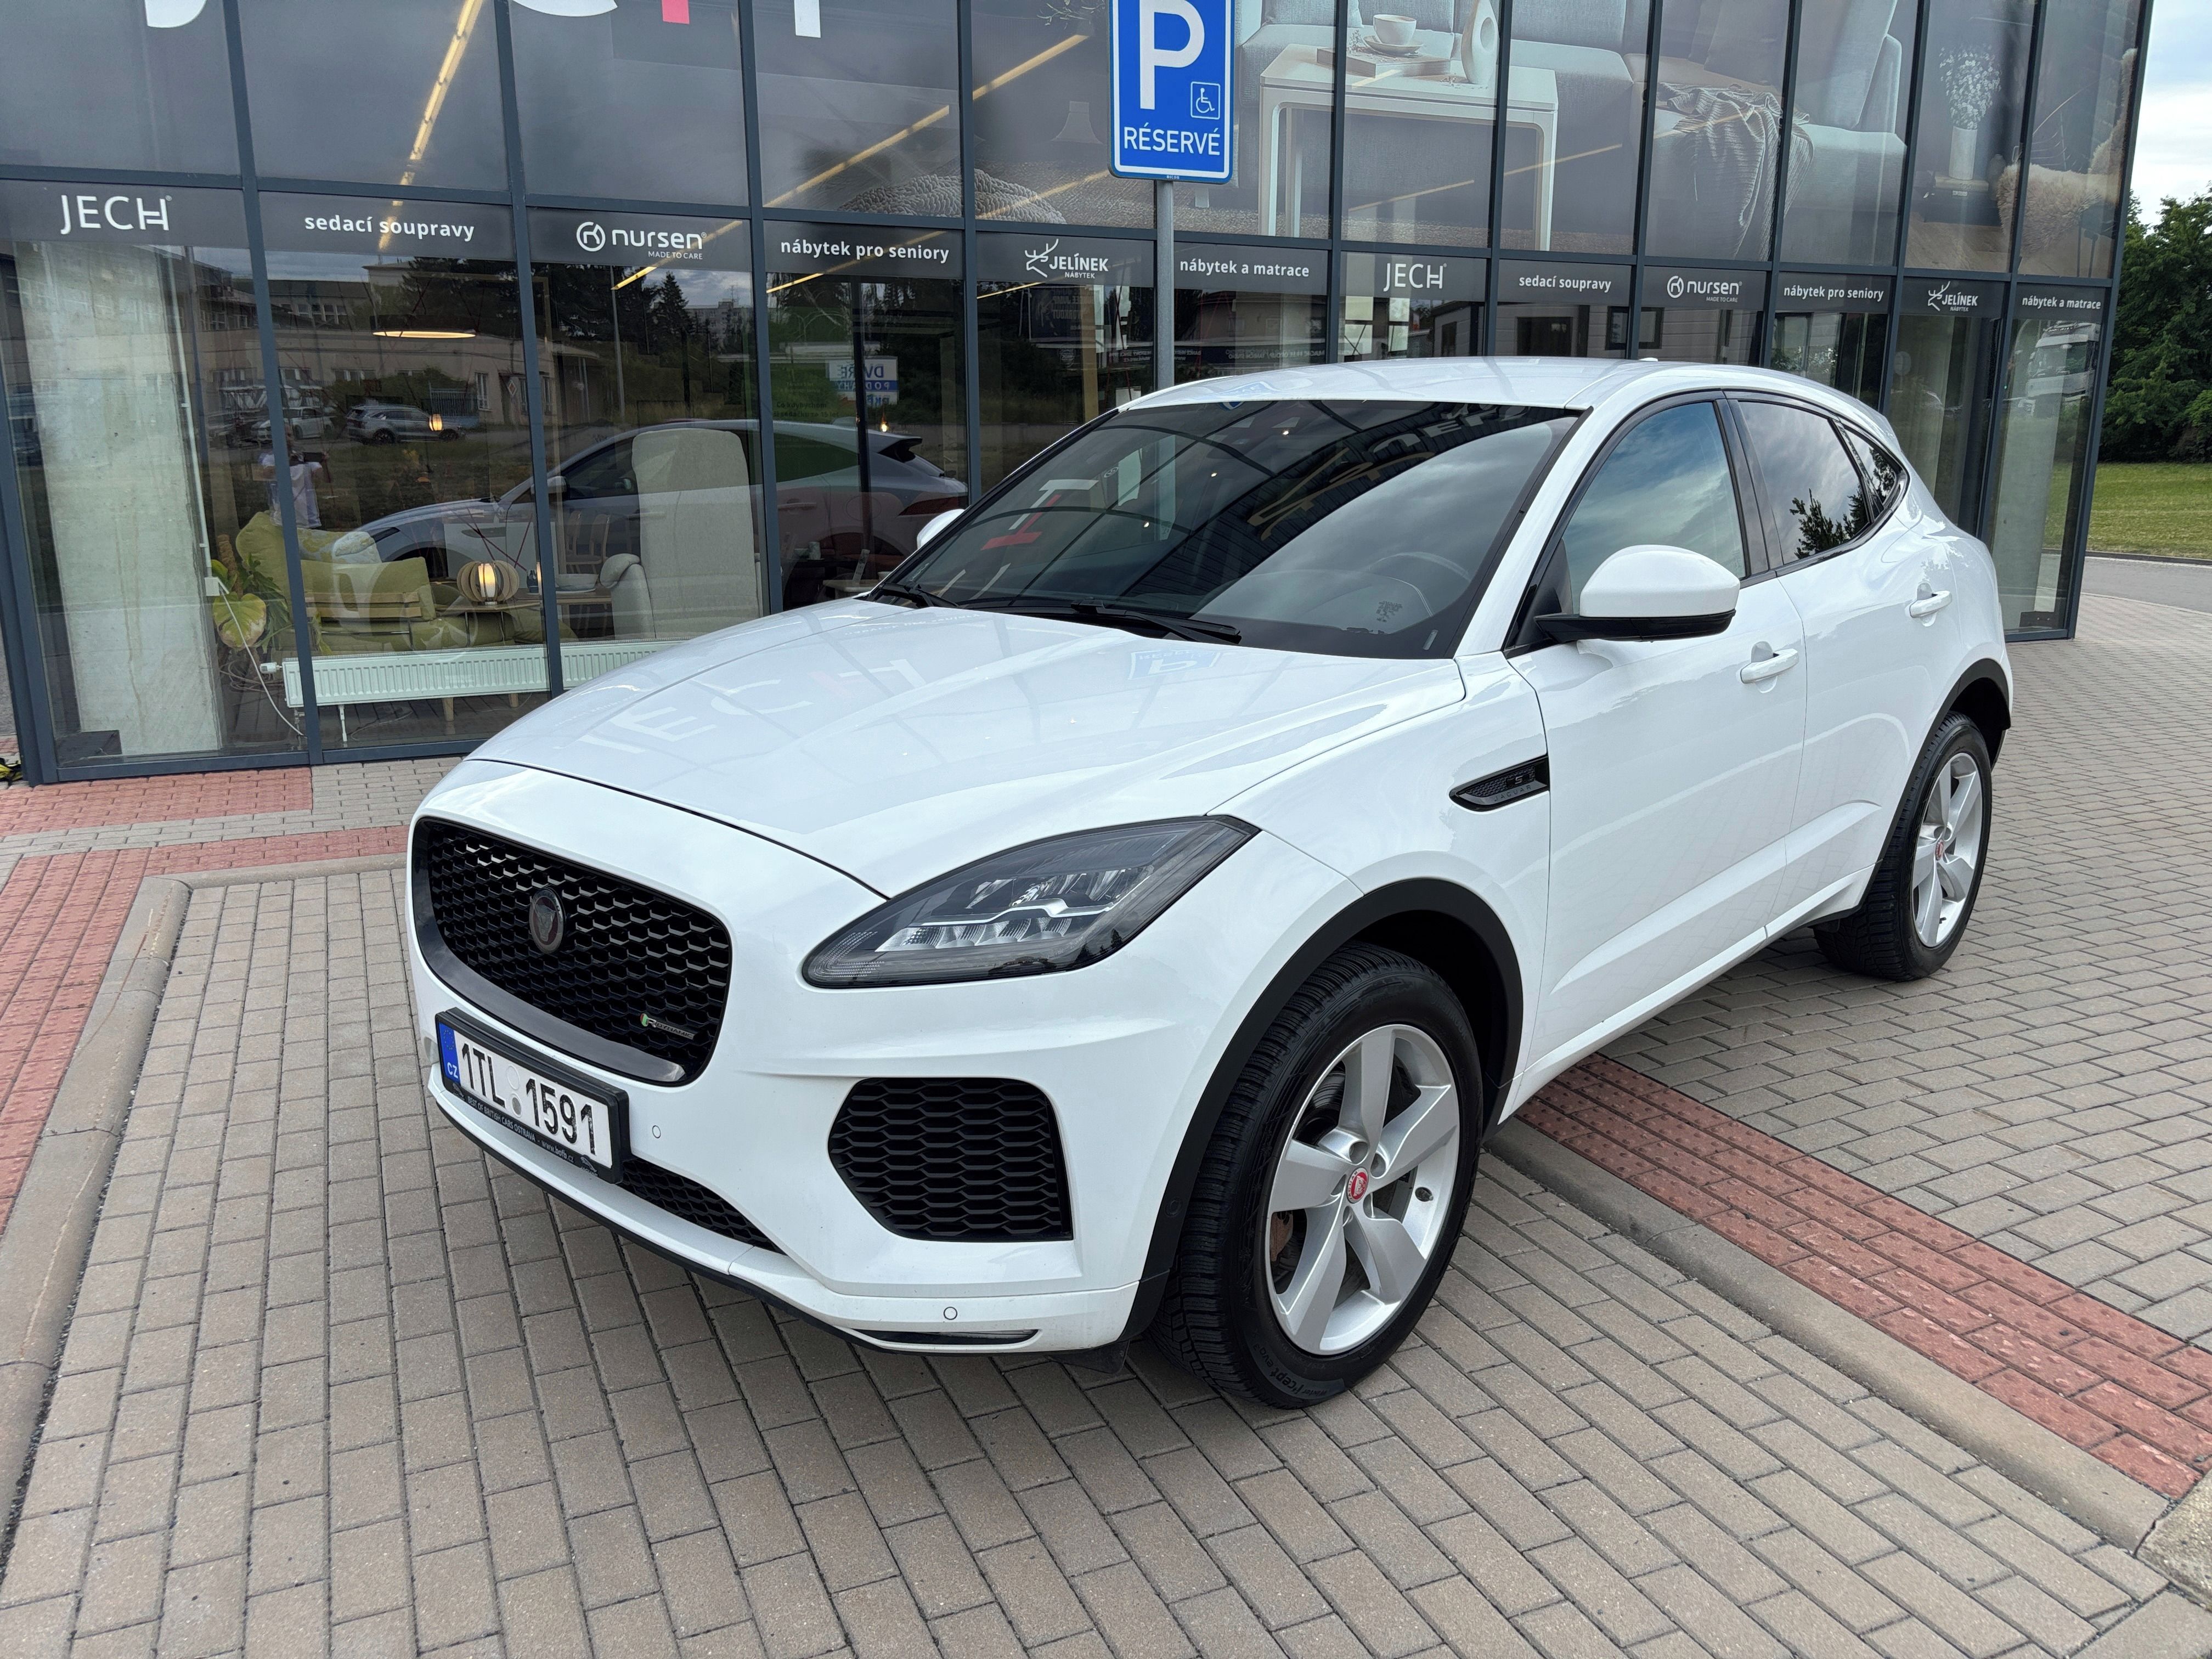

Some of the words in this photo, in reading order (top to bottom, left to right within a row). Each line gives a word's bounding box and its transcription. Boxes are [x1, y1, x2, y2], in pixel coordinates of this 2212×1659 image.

[1139, 0, 1206, 110] P
[1124, 122, 1221, 156] RÉSERVÉ
[60, 194, 170, 235] JECH
[304, 215, 373, 233] sedací
[379, 218, 475, 242] soupravy
[612, 229, 703, 250] nursen
[781, 239, 851, 258] nábytek
[856, 245, 884, 259] pro
[889, 245, 949, 263] seniory
[1049, 252, 1109, 272] JELÍNEK
[1180, 258, 1238, 276] nábytek
[1242, 264, 1249, 274] a
[1253, 263, 1310, 278] matrace
[1065, 271, 1096, 279] NÁBYTEK
[1383, 263, 1444, 292] JECH
[1519, 274, 1556, 288] sedací
[1559, 279, 1611, 293] soupravy
[1687, 281, 1739, 295] nursen
[1784, 284, 1825, 300] nábytek
[1827, 288, 1844, 300] pro
[1847, 288, 1884, 302] seniory
[1942, 291, 1978, 306] JELÍNEK
[2022, 296, 2058, 309] nábytek
[2066, 299, 2101, 309] matrace
[1494, 784, 1532, 802] JAGUAR
[447, 1062, 459, 1079] CZ
[461, 1042, 505, 1108] 1TL
[526, 1077, 596, 1155] 1591
[467, 1096, 478, 1109] BEST
[477, 1102, 484, 1113] OF
[484, 1105, 502, 1122] BRITISH
[501, 1116, 515, 1132] CARS
[514, 1123, 537, 1143] OSTRAVA
[541, 1139, 575, 1164] www.bofb.cz
